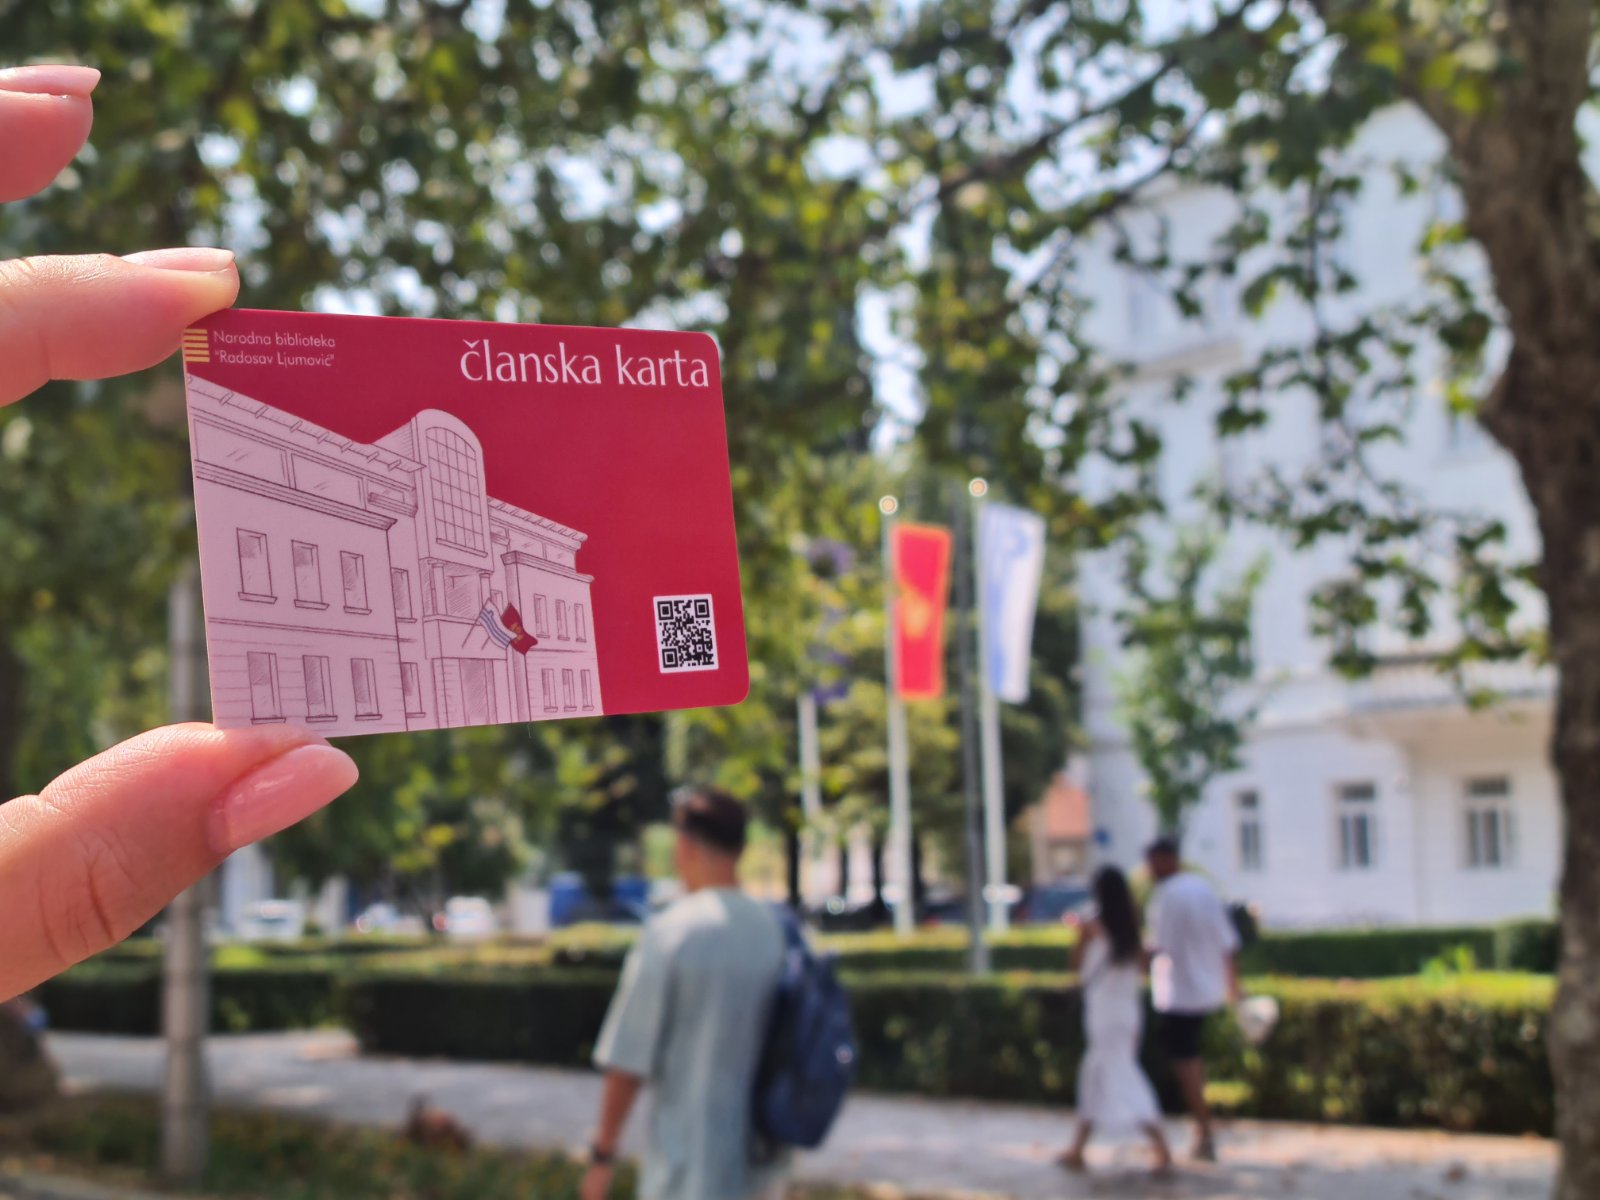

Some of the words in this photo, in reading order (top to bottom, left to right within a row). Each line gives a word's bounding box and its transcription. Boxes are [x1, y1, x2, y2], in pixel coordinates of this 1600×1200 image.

[213, 330, 272, 346] Narodna
[275, 331, 336, 348] biblioteka
[215, 349, 273, 365] "Radosav
[460, 338, 602, 385] članska
[615, 343, 709, 388] karta
